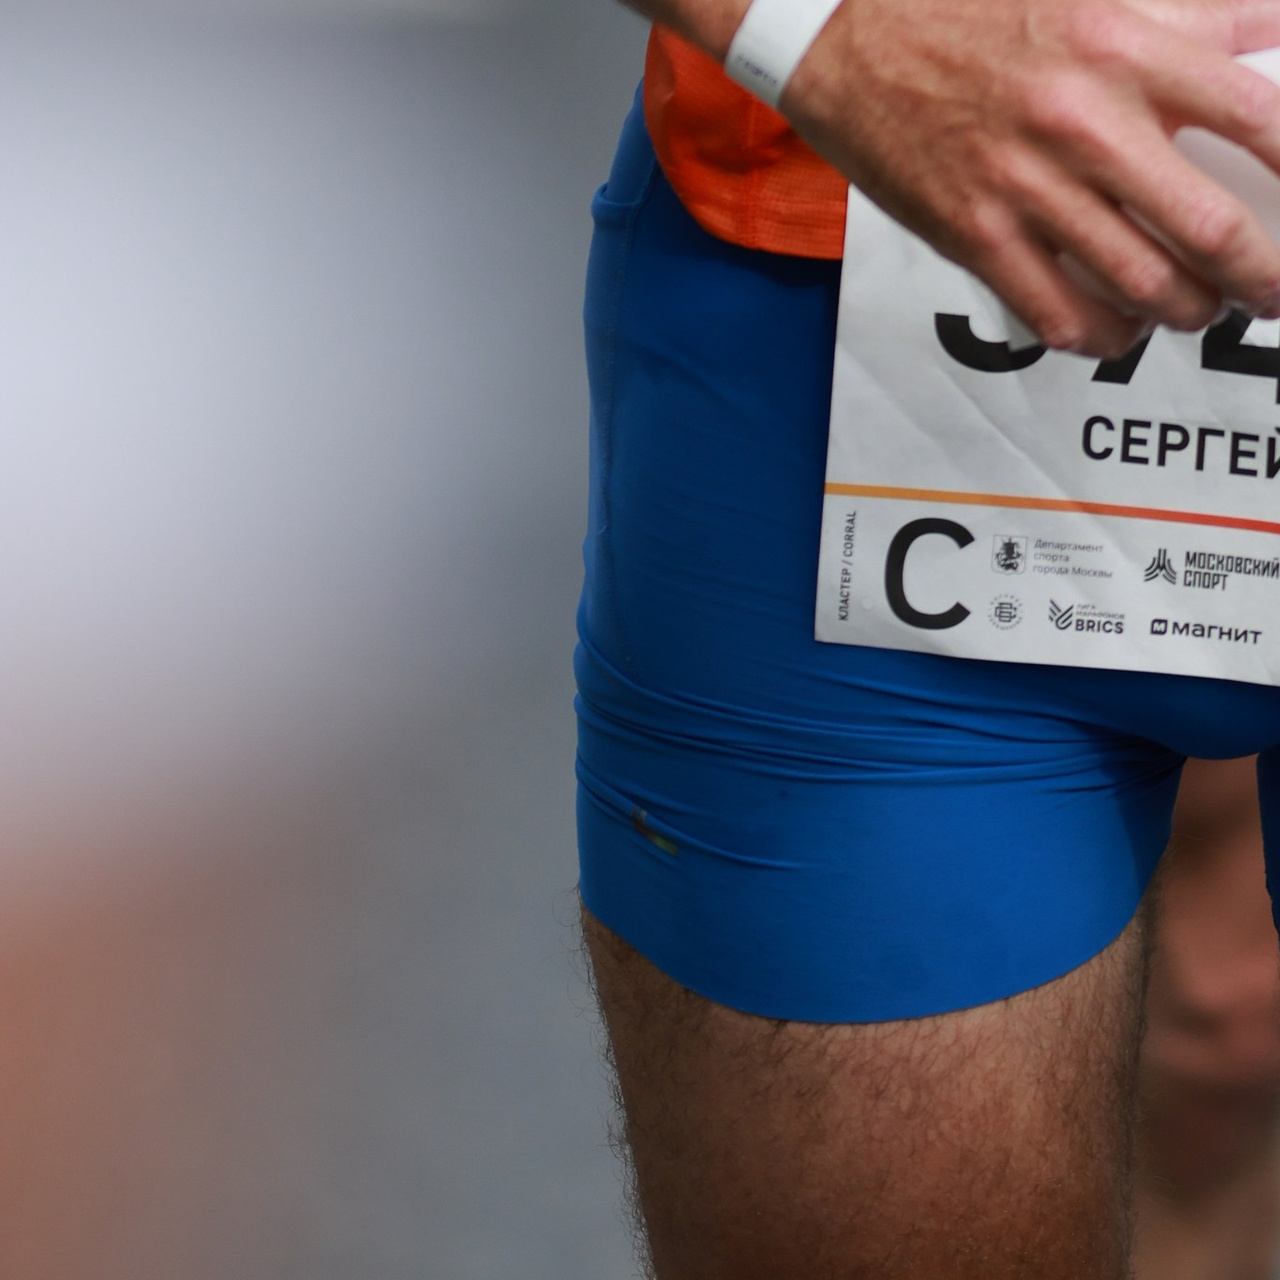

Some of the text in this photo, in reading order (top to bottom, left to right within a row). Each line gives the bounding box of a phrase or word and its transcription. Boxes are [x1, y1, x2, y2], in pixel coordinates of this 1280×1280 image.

[842, 510, 857, 559] CORRAL
[1184, 550, 1280, 579] МОСКОВСКИЙ
[1183, 569, 1229, 591] СПОРТ
[838, 568, 852, 622] КЛАСТЕР
[1075, 618, 1124, 635] BRICS
[1172, 621, 1262, 645] магнит
